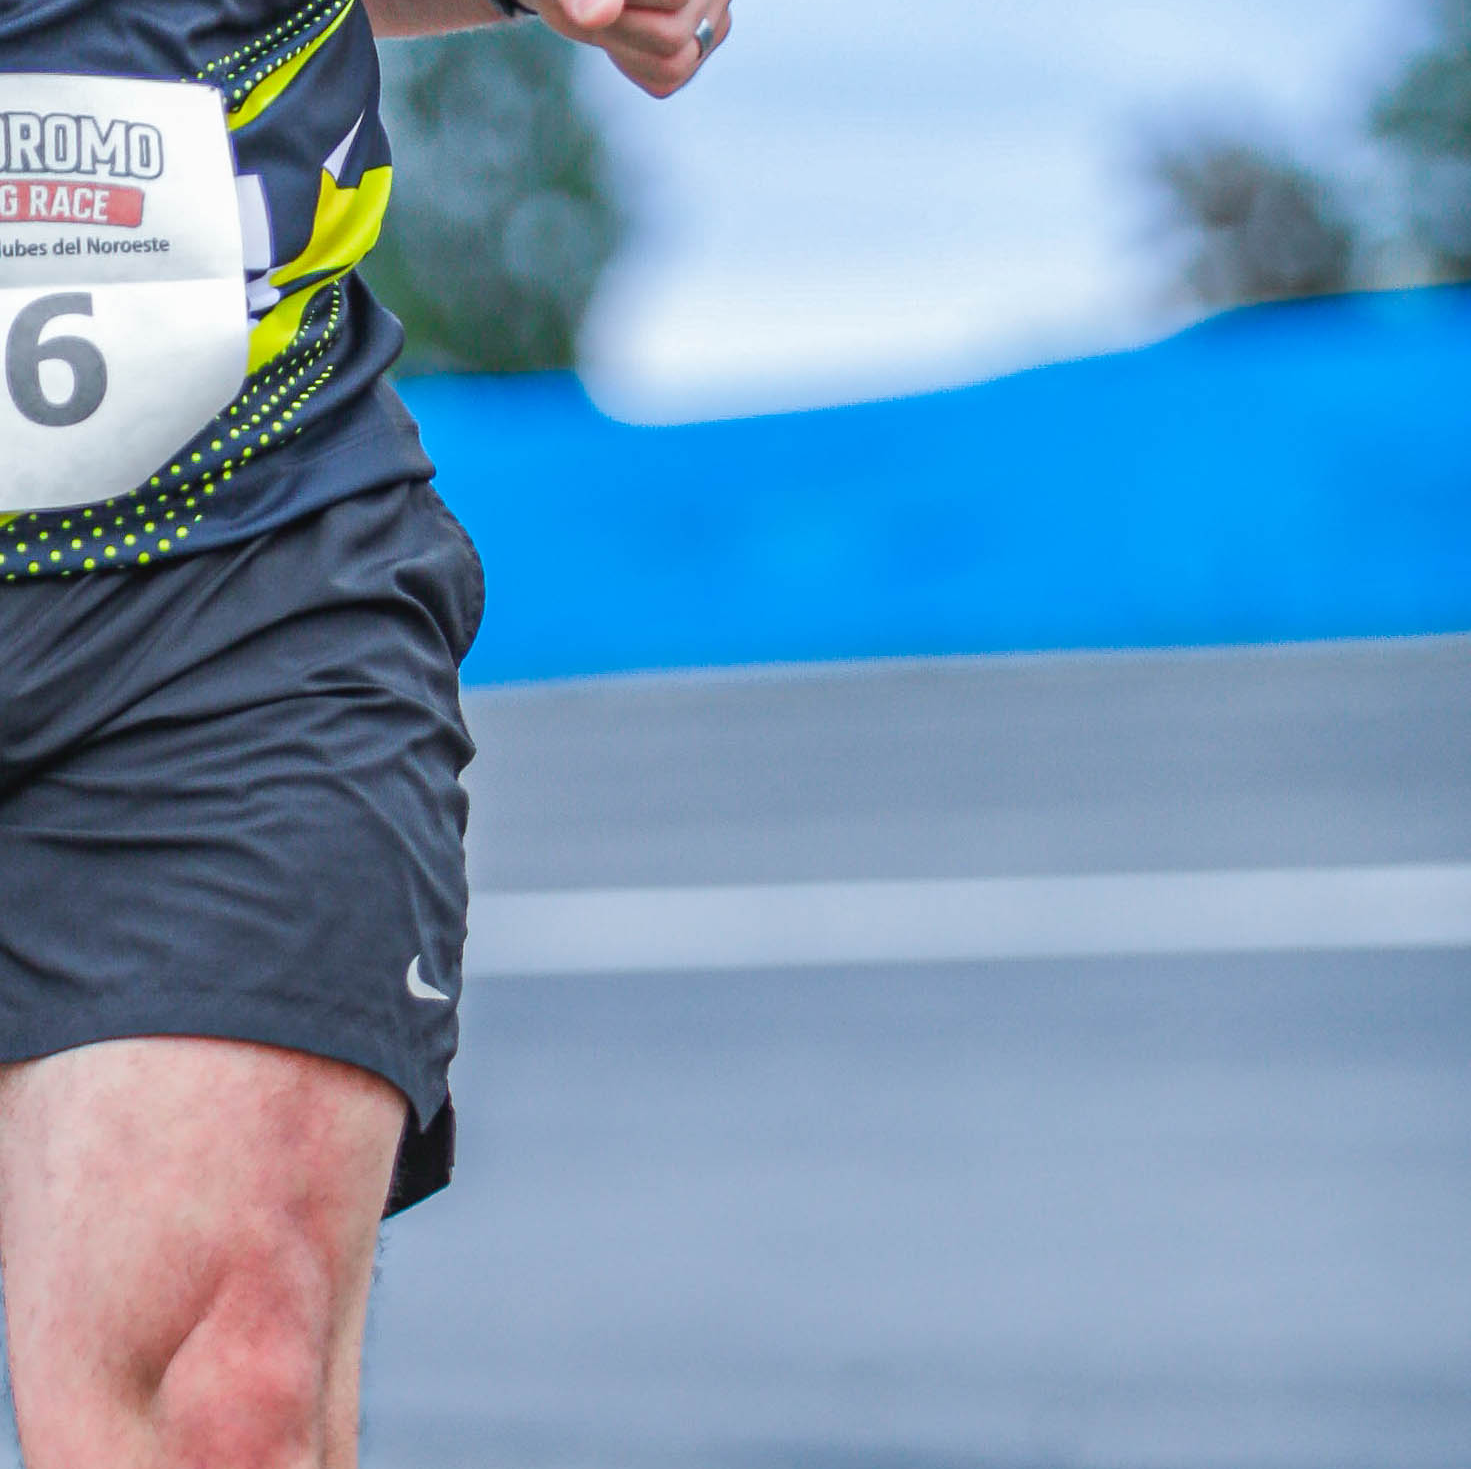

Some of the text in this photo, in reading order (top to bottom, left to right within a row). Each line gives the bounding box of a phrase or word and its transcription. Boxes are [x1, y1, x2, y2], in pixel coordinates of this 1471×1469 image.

[29, 185, 108, 221] RACE
[52, 237, 81, 255] del
[86, 237, 170, 255] Noroeste
